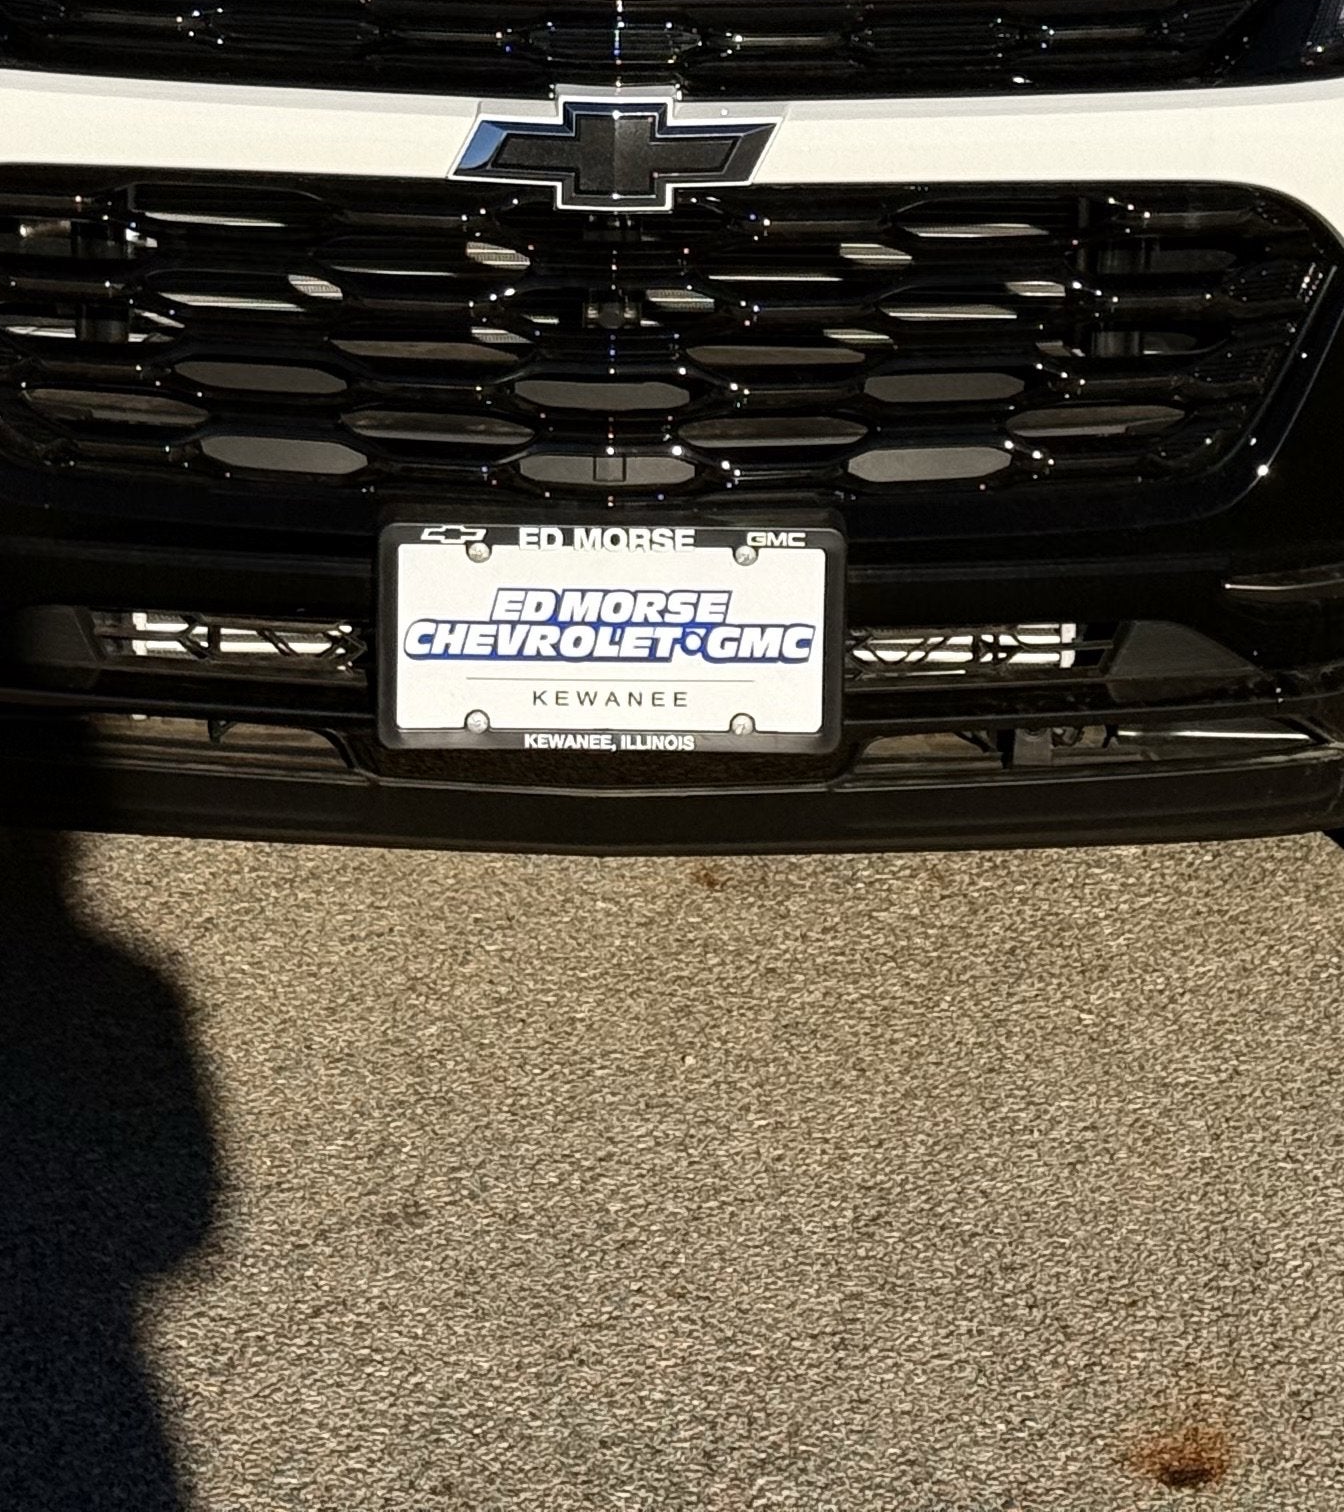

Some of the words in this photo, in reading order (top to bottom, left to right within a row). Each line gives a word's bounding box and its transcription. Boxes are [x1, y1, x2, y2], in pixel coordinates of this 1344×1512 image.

[518, 526, 563, 550] ED
[573, 527, 696, 553] MORSE
[746, 531, 806, 548] GMC
[490, 588, 561, 623] ED
[557, 589, 733, 625] MORSE
[404, 619, 684, 661] CHEVROLET
[703, 624, 816, 664] GMC
[532, 690, 688, 707] KEWANEE
[524, 734, 617, 751] KEWANEE,
[620, 735, 695, 751] ILLINOIS
